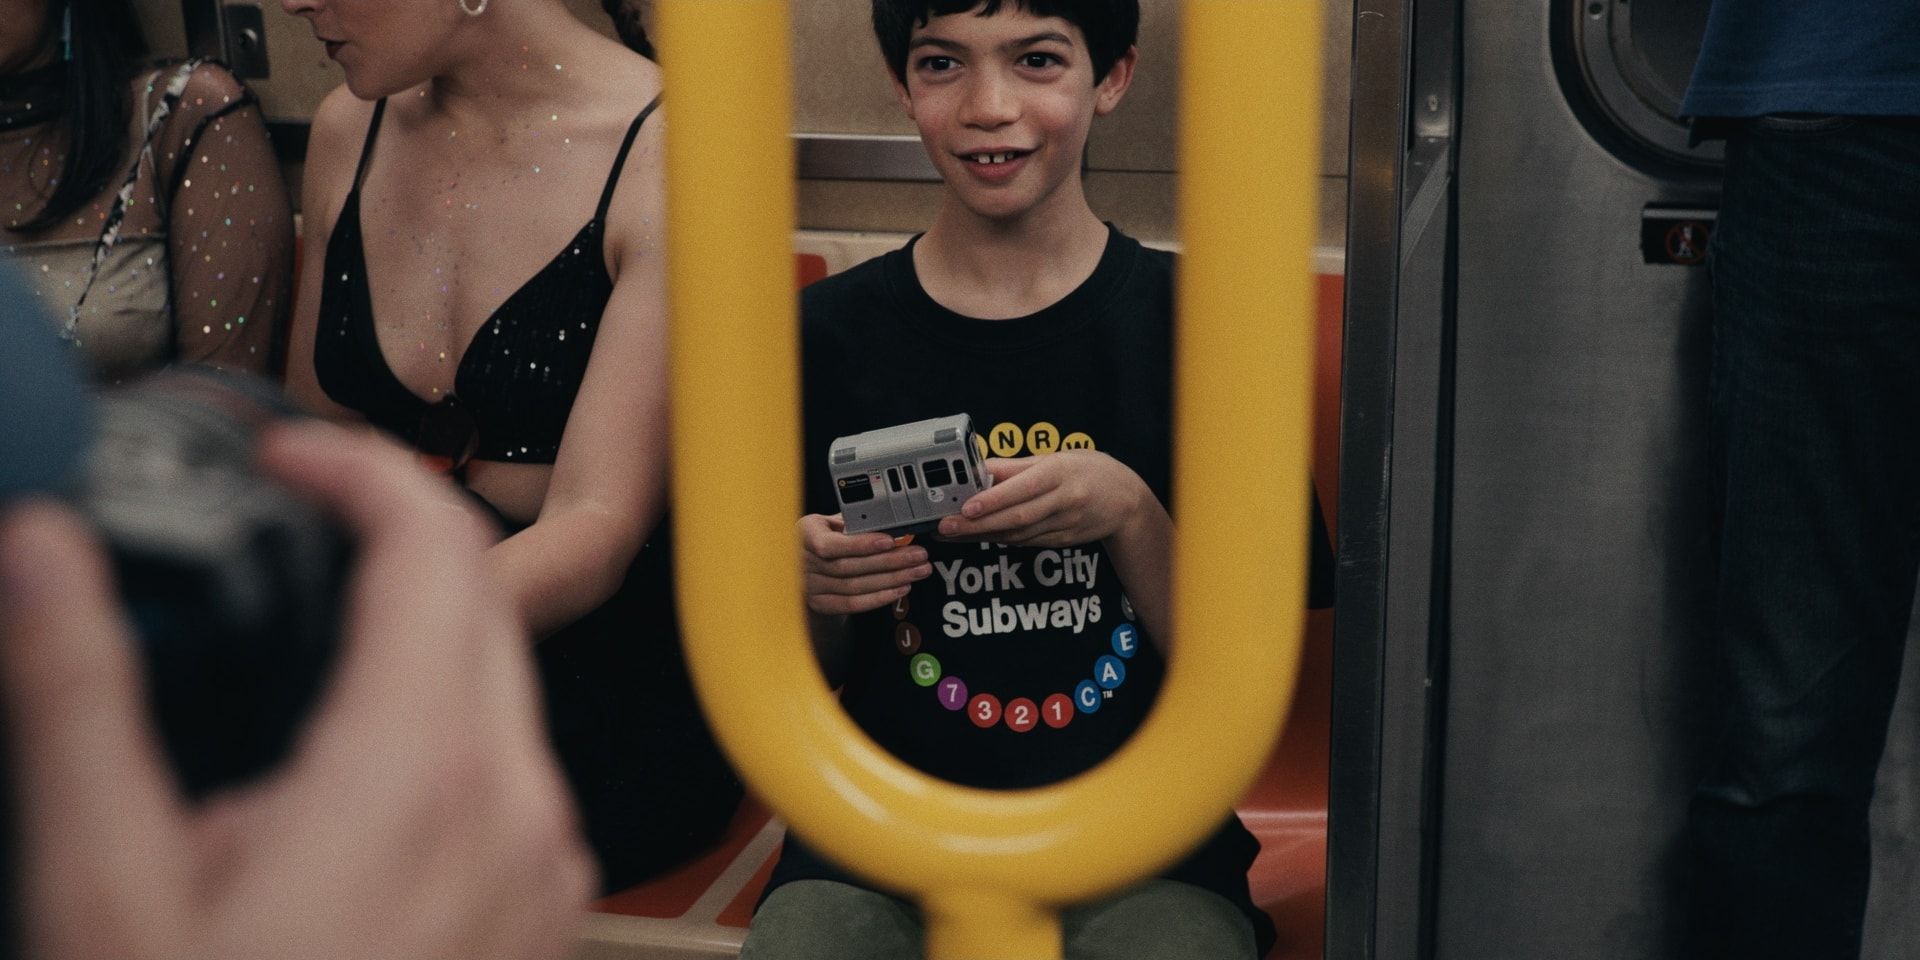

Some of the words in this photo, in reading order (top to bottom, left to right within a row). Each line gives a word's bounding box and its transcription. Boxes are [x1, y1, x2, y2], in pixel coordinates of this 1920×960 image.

[998, 430, 1015, 450] N
[1034, 430, 1051, 449] R
[933, 554, 1025, 596] York
[1033, 548, 1099, 590] City
[942, 594, 1102, 638] Subways
[901, 628, 912, 648] J
[916, 660, 935, 680] G
[946, 683, 958, 703] 7
[977, 700, 993, 721] 3
[1013, 705, 1030, 725] 2
[1051, 701, 1062, 721] 1
[1080, 686, 1096, 707] C
[1101, 661, 1119, 682] A
[1119, 629, 1134, 652] E
[1102, 690, 1114, 699] TM
